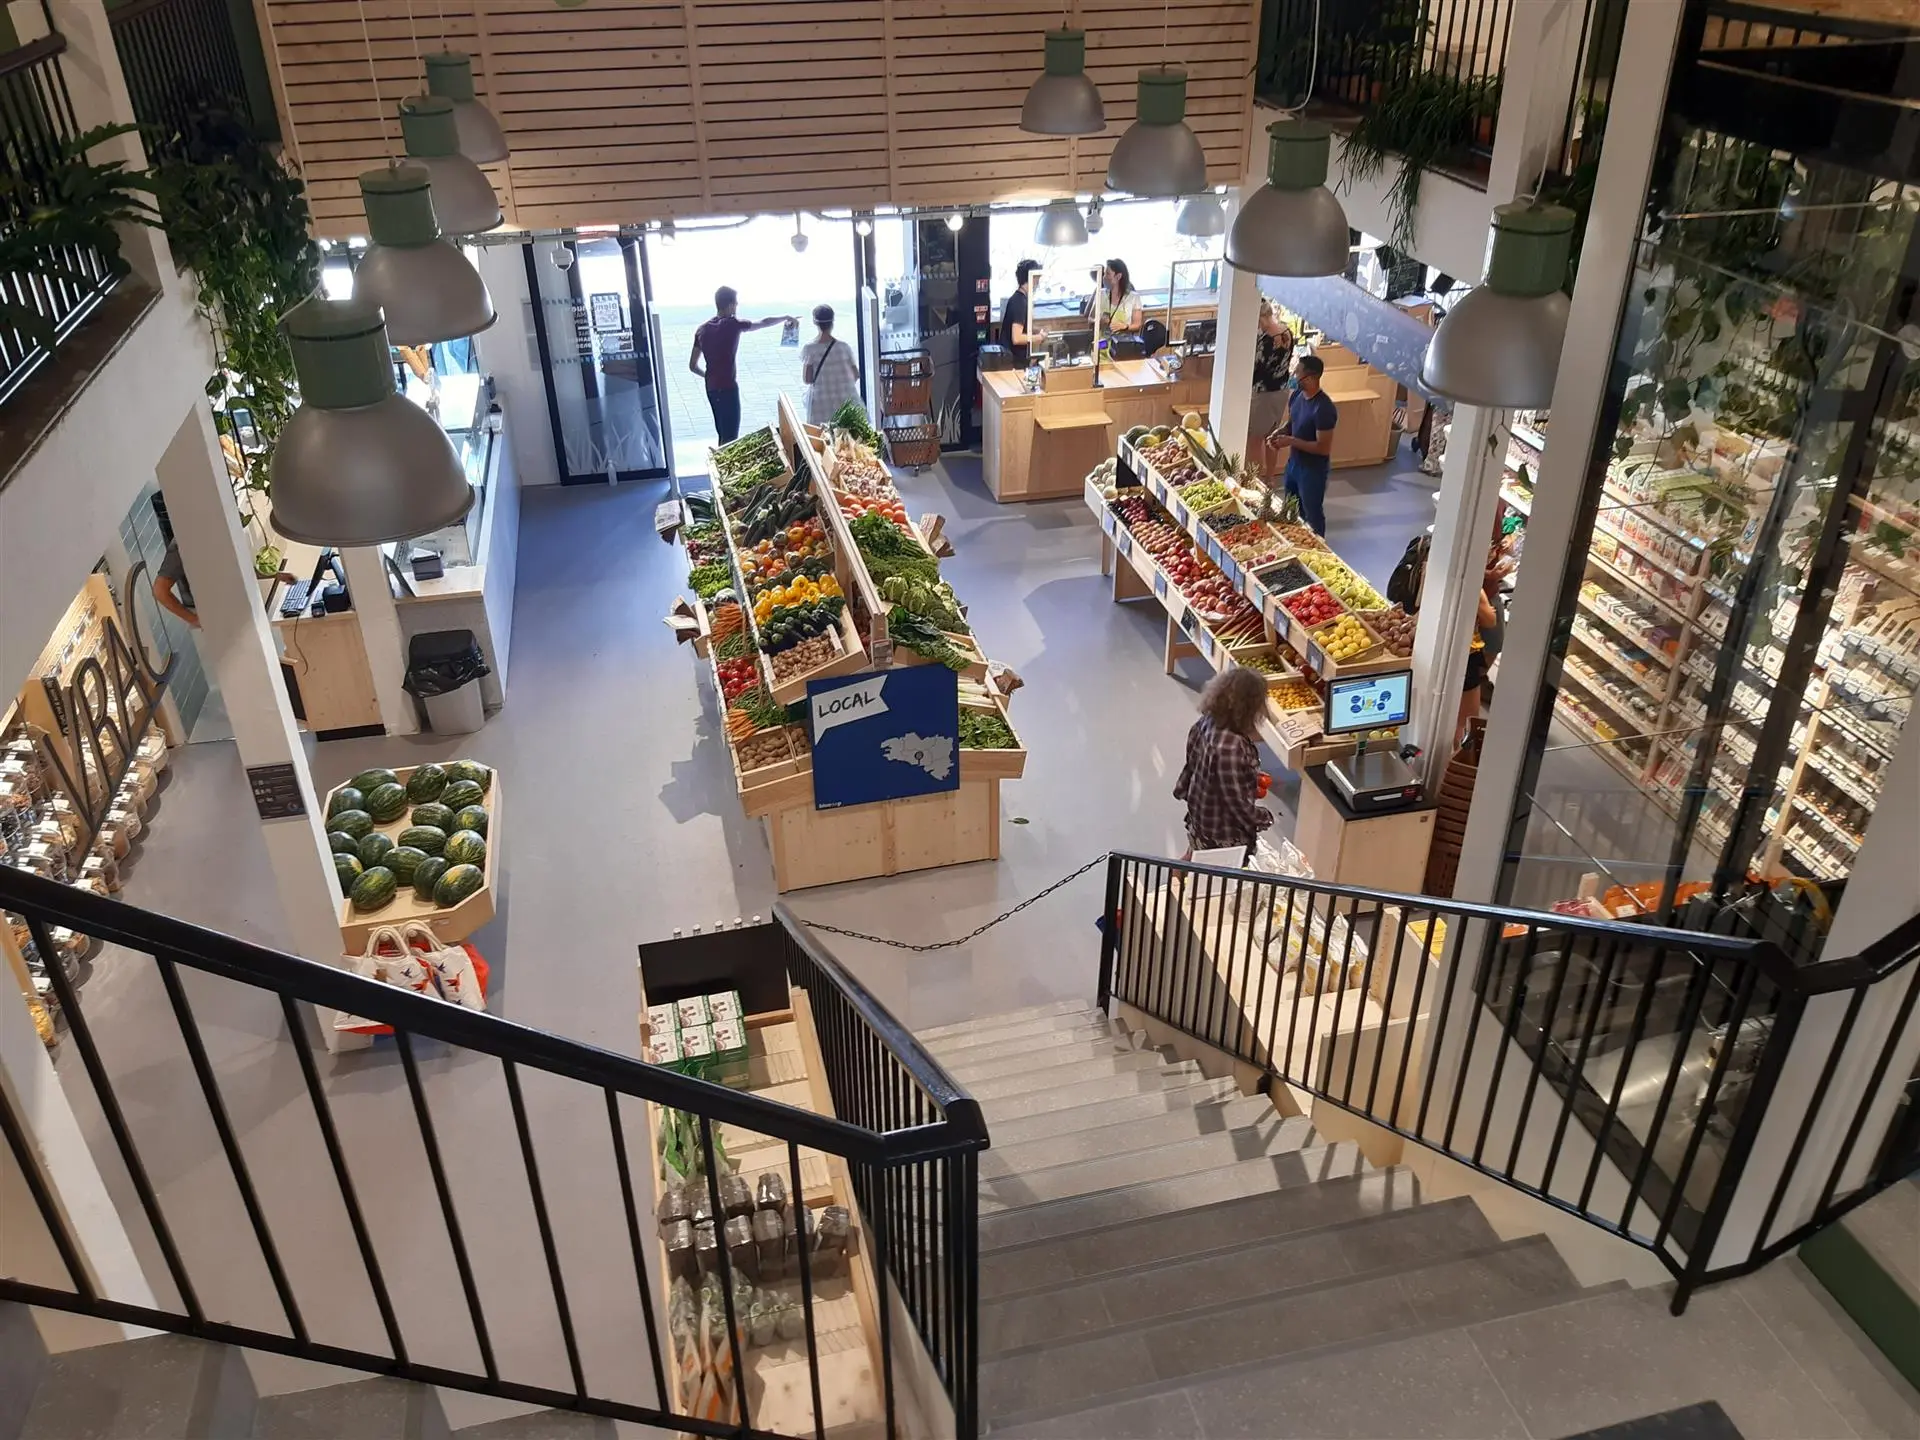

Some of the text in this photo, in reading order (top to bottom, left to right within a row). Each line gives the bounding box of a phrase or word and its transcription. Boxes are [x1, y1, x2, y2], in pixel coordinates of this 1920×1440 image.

[42, 560, 174, 834] VRAC
[818, 691, 876, 718] LOCAL
[1281, 719, 1304, 739] BIO
